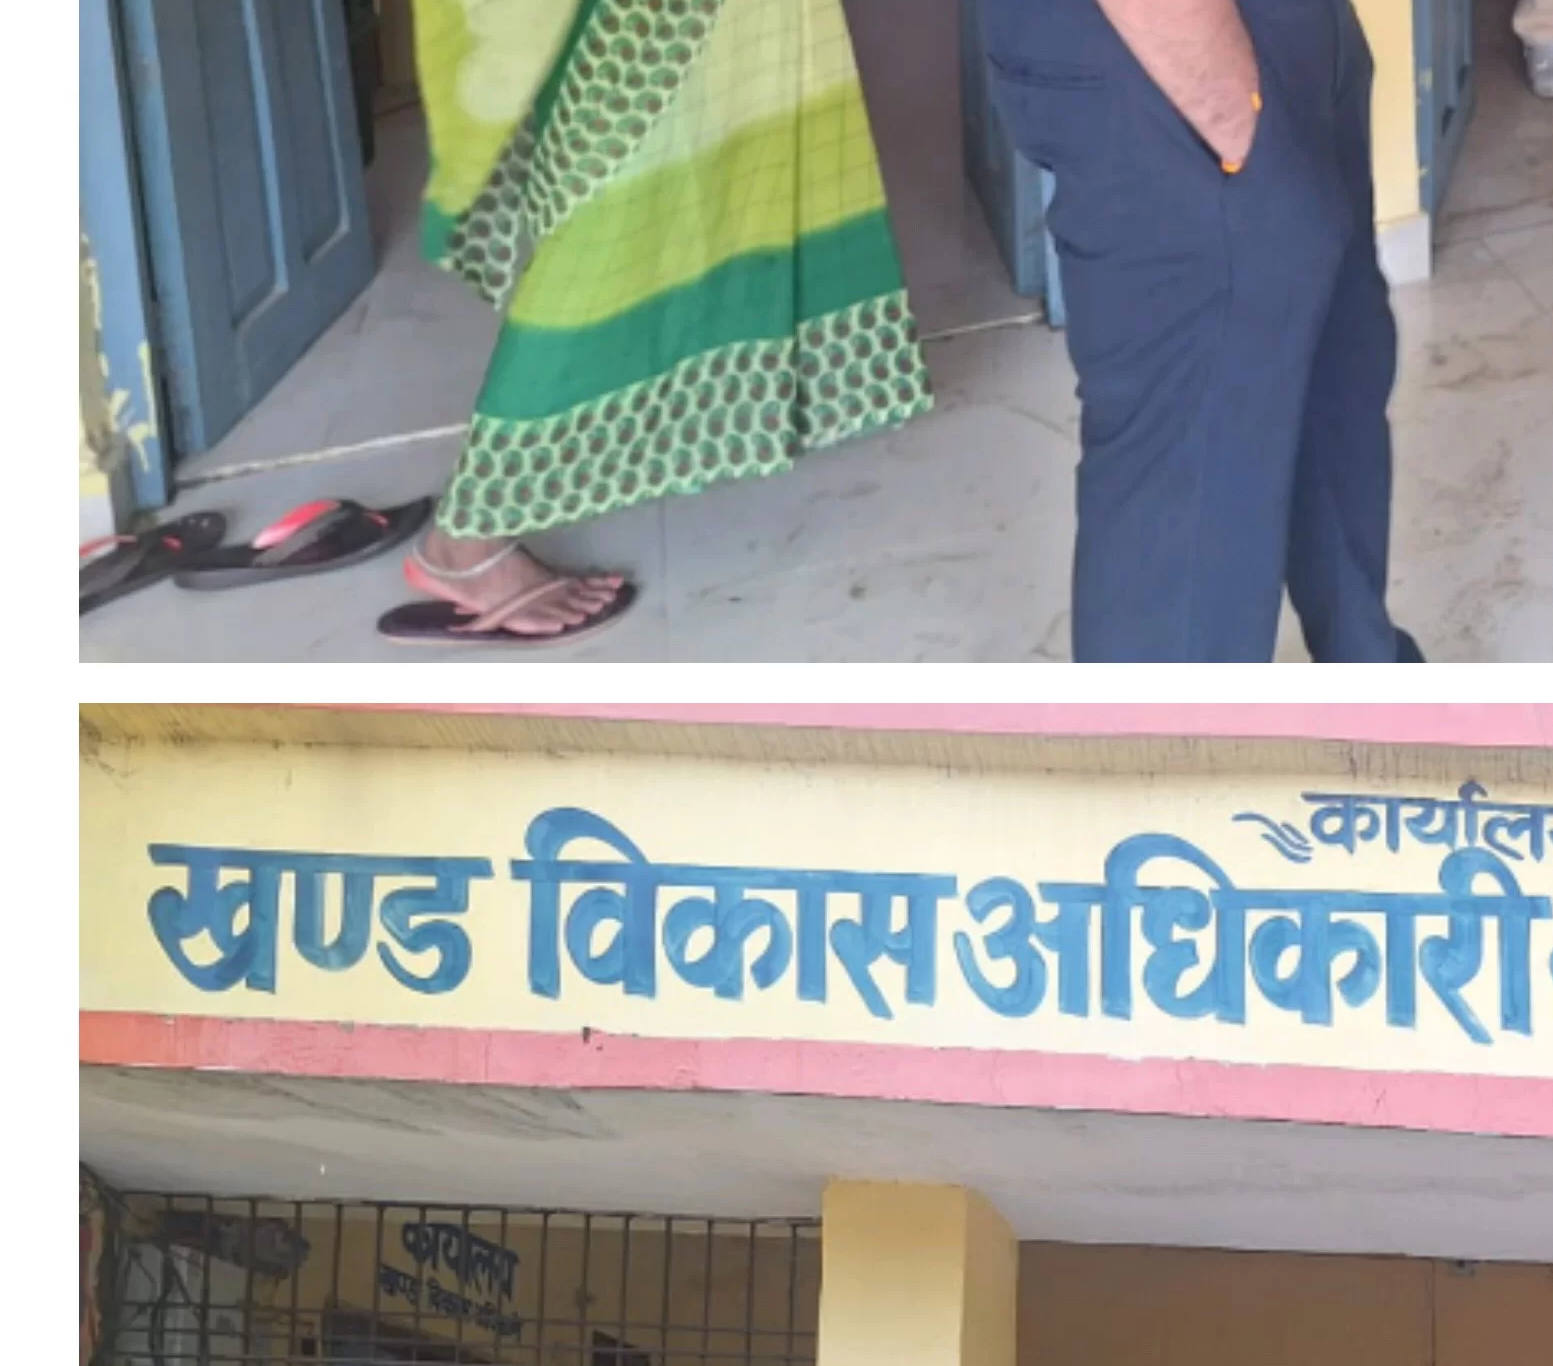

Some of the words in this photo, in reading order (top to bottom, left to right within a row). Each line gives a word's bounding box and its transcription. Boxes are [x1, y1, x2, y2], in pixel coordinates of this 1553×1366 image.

[146, 842, 494, 996] खण्ड
[510, 807, 958, 1019] विकास
[953, 831, 1552, 1046] अधिकारी
